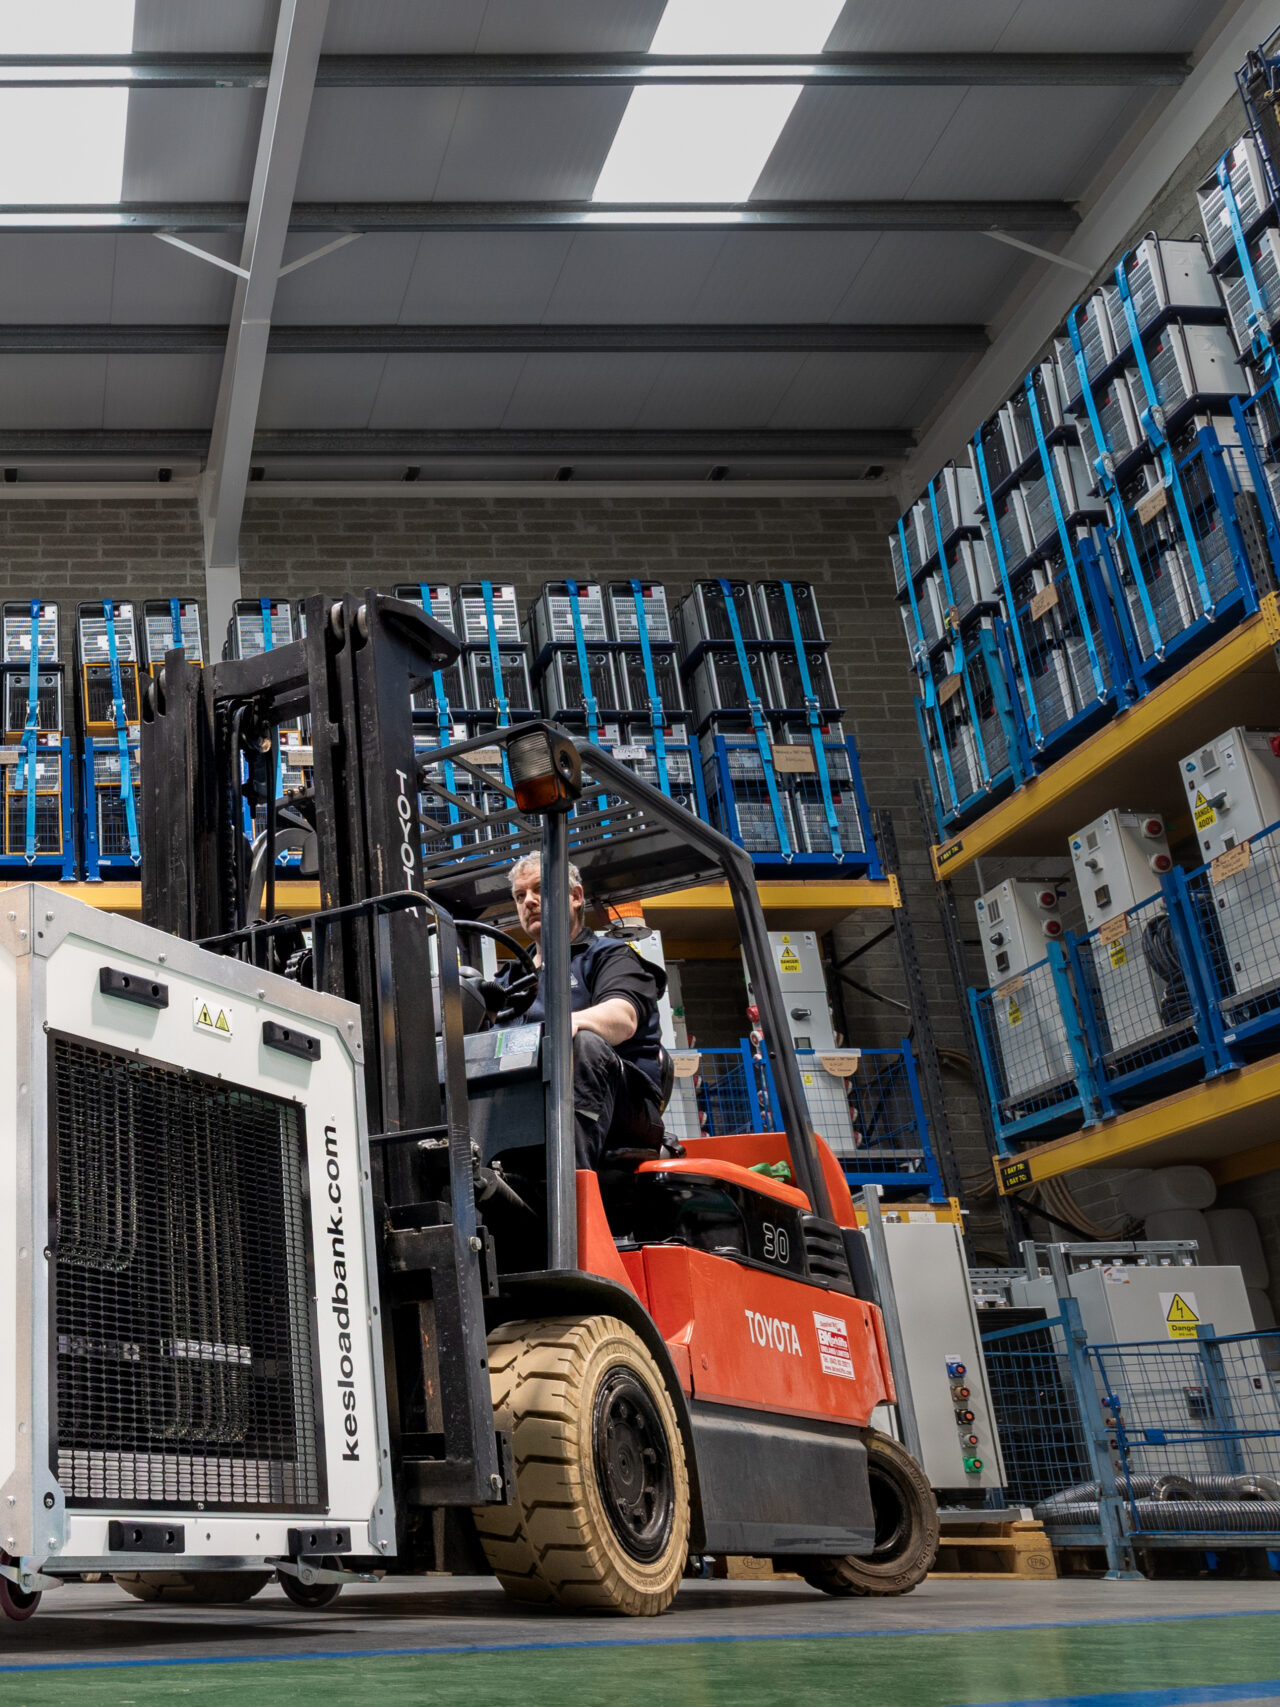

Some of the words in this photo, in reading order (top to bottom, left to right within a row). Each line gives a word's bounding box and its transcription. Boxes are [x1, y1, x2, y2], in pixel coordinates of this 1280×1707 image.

[1198, 818, 1214, 829] 400V
[763, 1222, 789, 1264] 30
[324, 1125, 360, 1461] kesloadbank.com
[745, 1309, 802, 1357] TOYOTA
[1171, 1325, 1196, 1333] Dange
